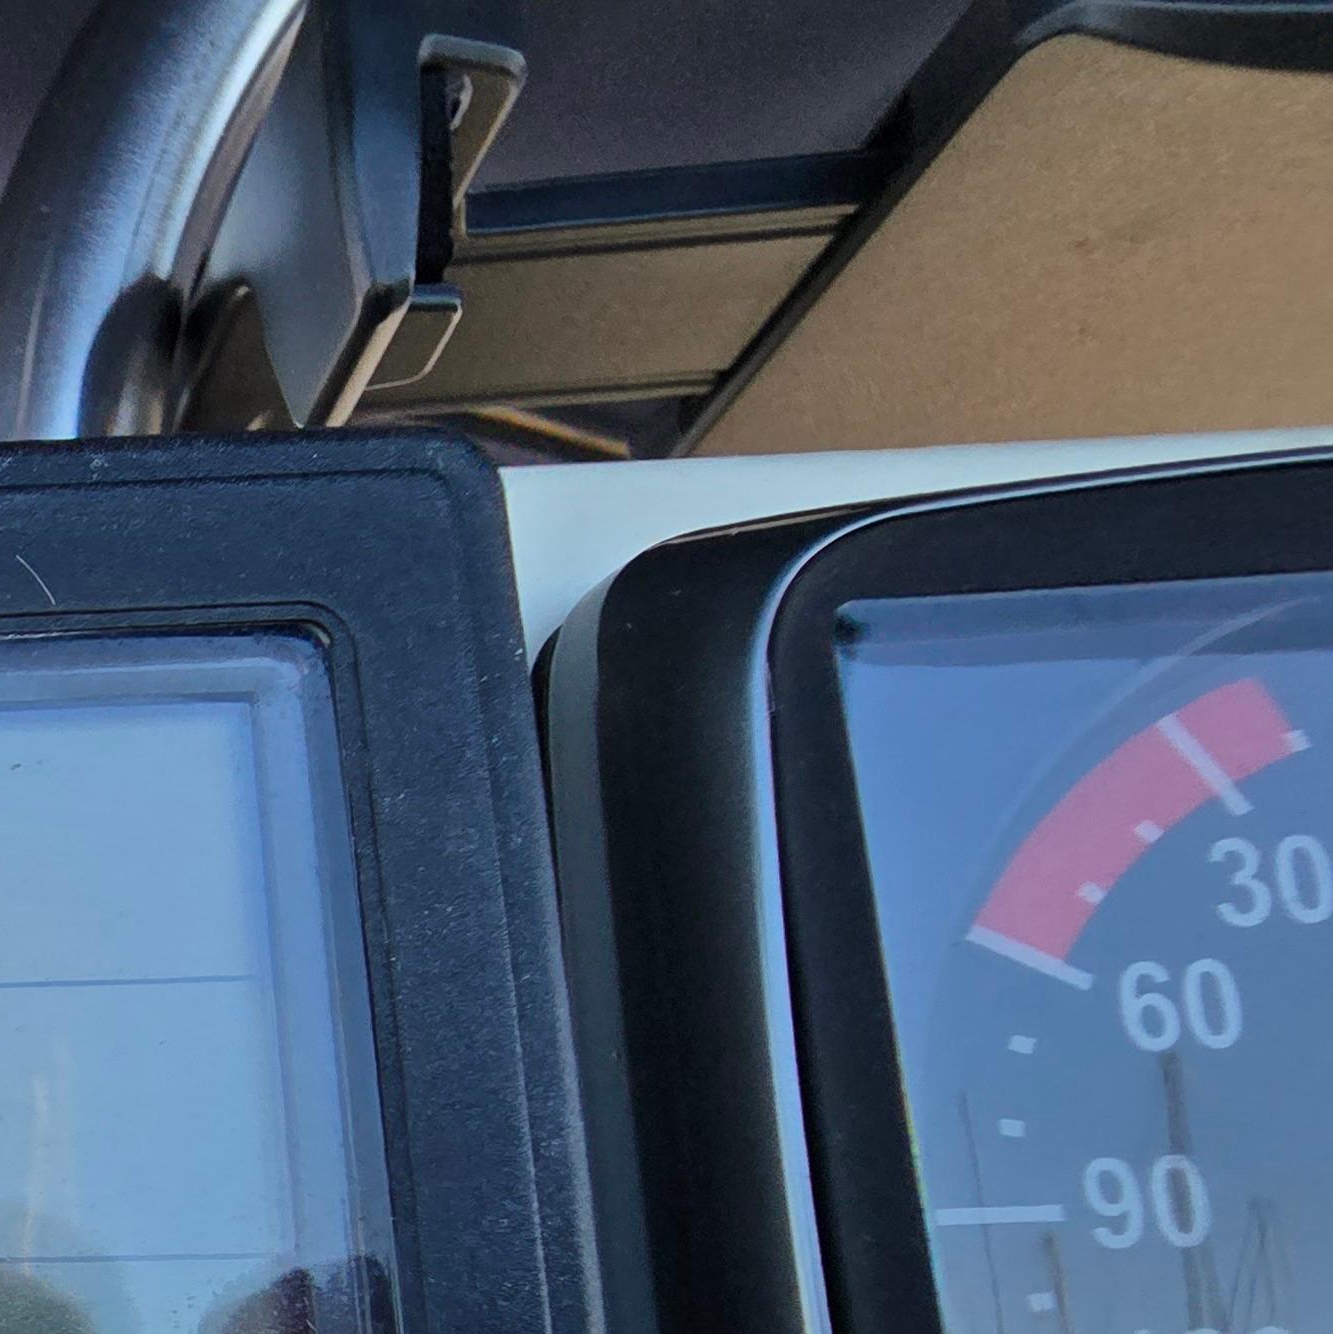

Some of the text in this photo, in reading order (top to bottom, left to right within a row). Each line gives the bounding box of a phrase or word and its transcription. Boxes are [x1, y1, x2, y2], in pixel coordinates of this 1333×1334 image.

[1208, 834, 1333, 928] 30
[1119, 958, 1242, 1052] 60
[1084, 1155, 1208, 1248] 90
